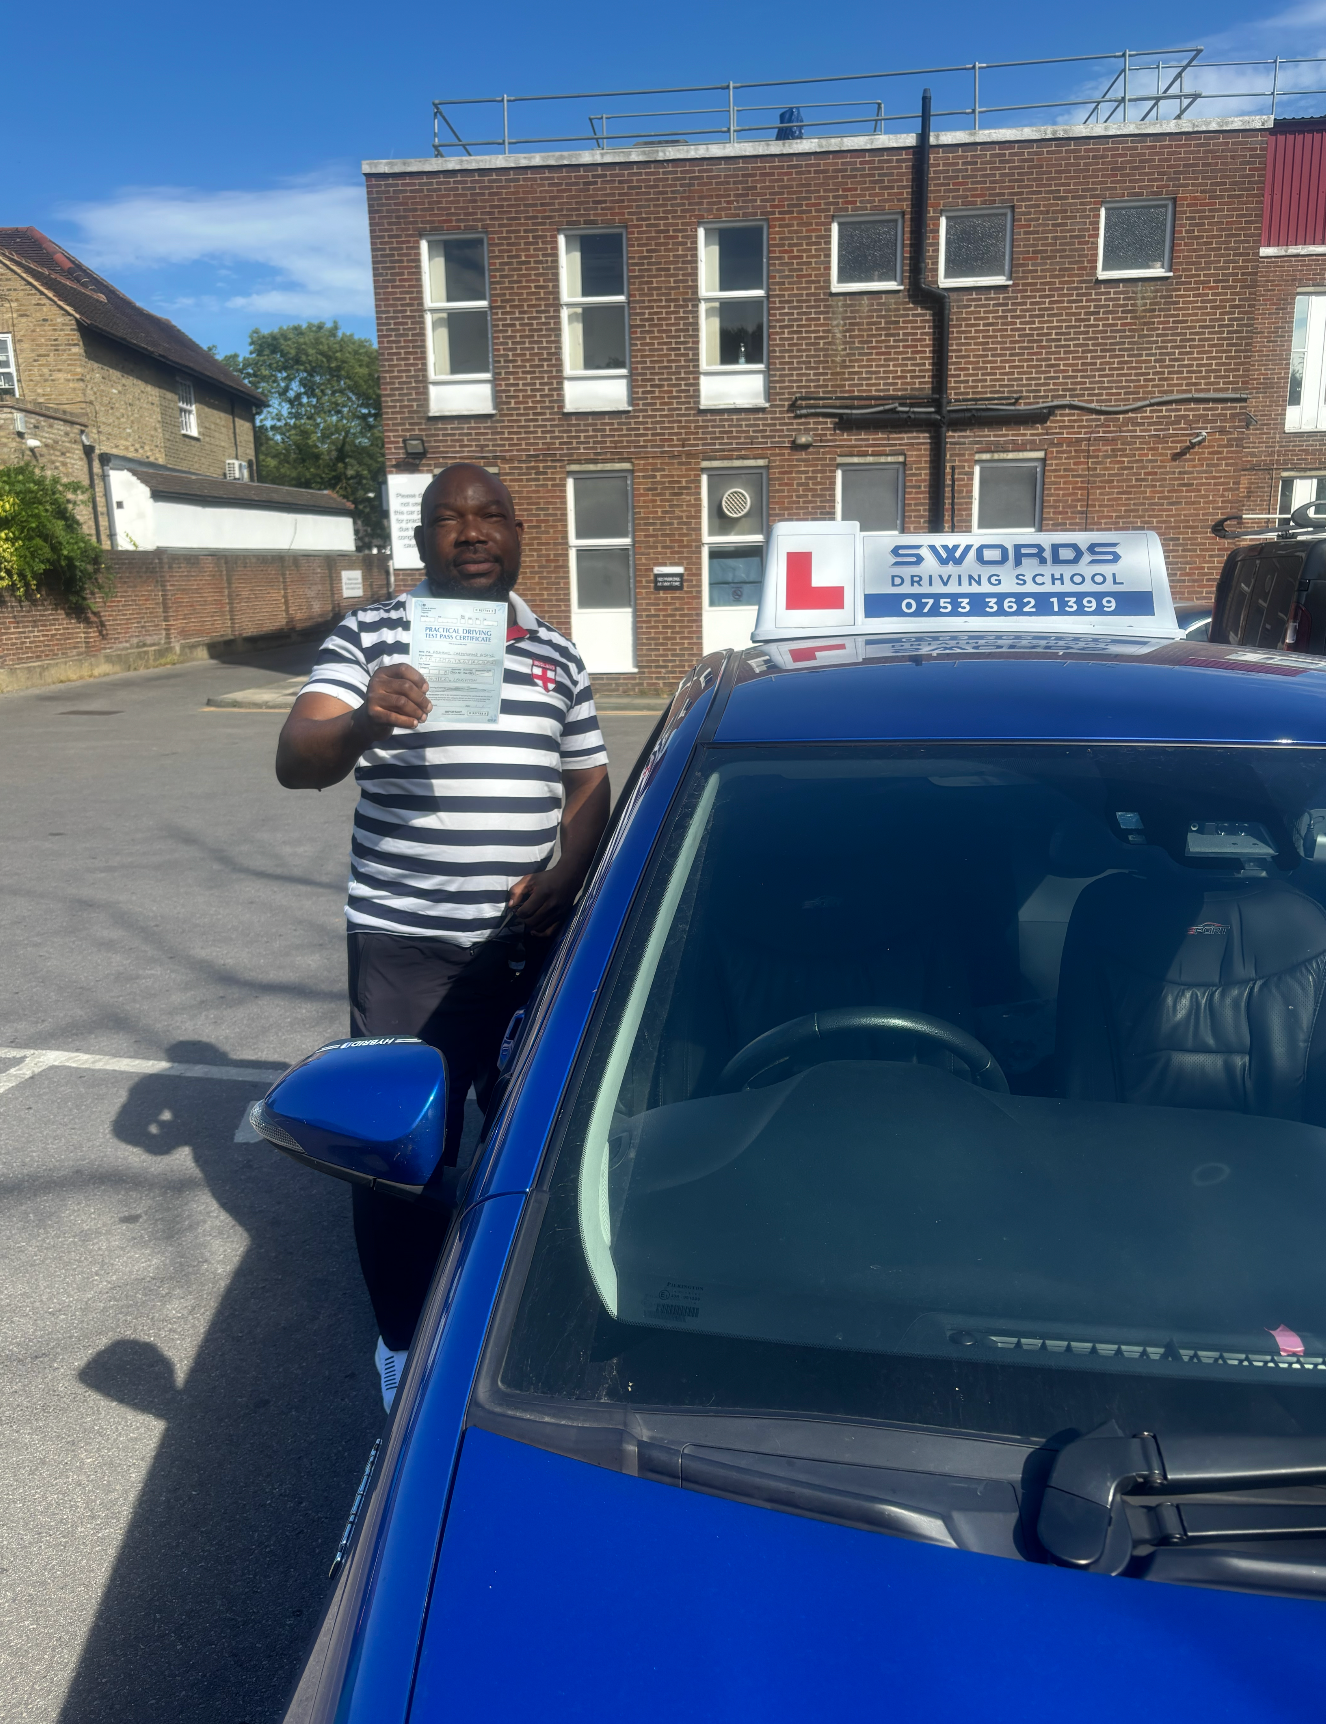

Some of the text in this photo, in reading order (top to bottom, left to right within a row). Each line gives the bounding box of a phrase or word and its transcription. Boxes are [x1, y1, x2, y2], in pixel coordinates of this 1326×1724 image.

[889, 542, 1122, 569] SWORDS
[786, 551, 845, 611] L
[890, 572, 1125, 588] DRIVING SCHOOL
[901, 597, 1117, 613] 0753 362 1399
[425, 626, 492, 637] PRACTICAL DRIVING
[455, 635, 492, 643] CERTIFICATE
[351, 1038, 395, 1047] HYBRID
